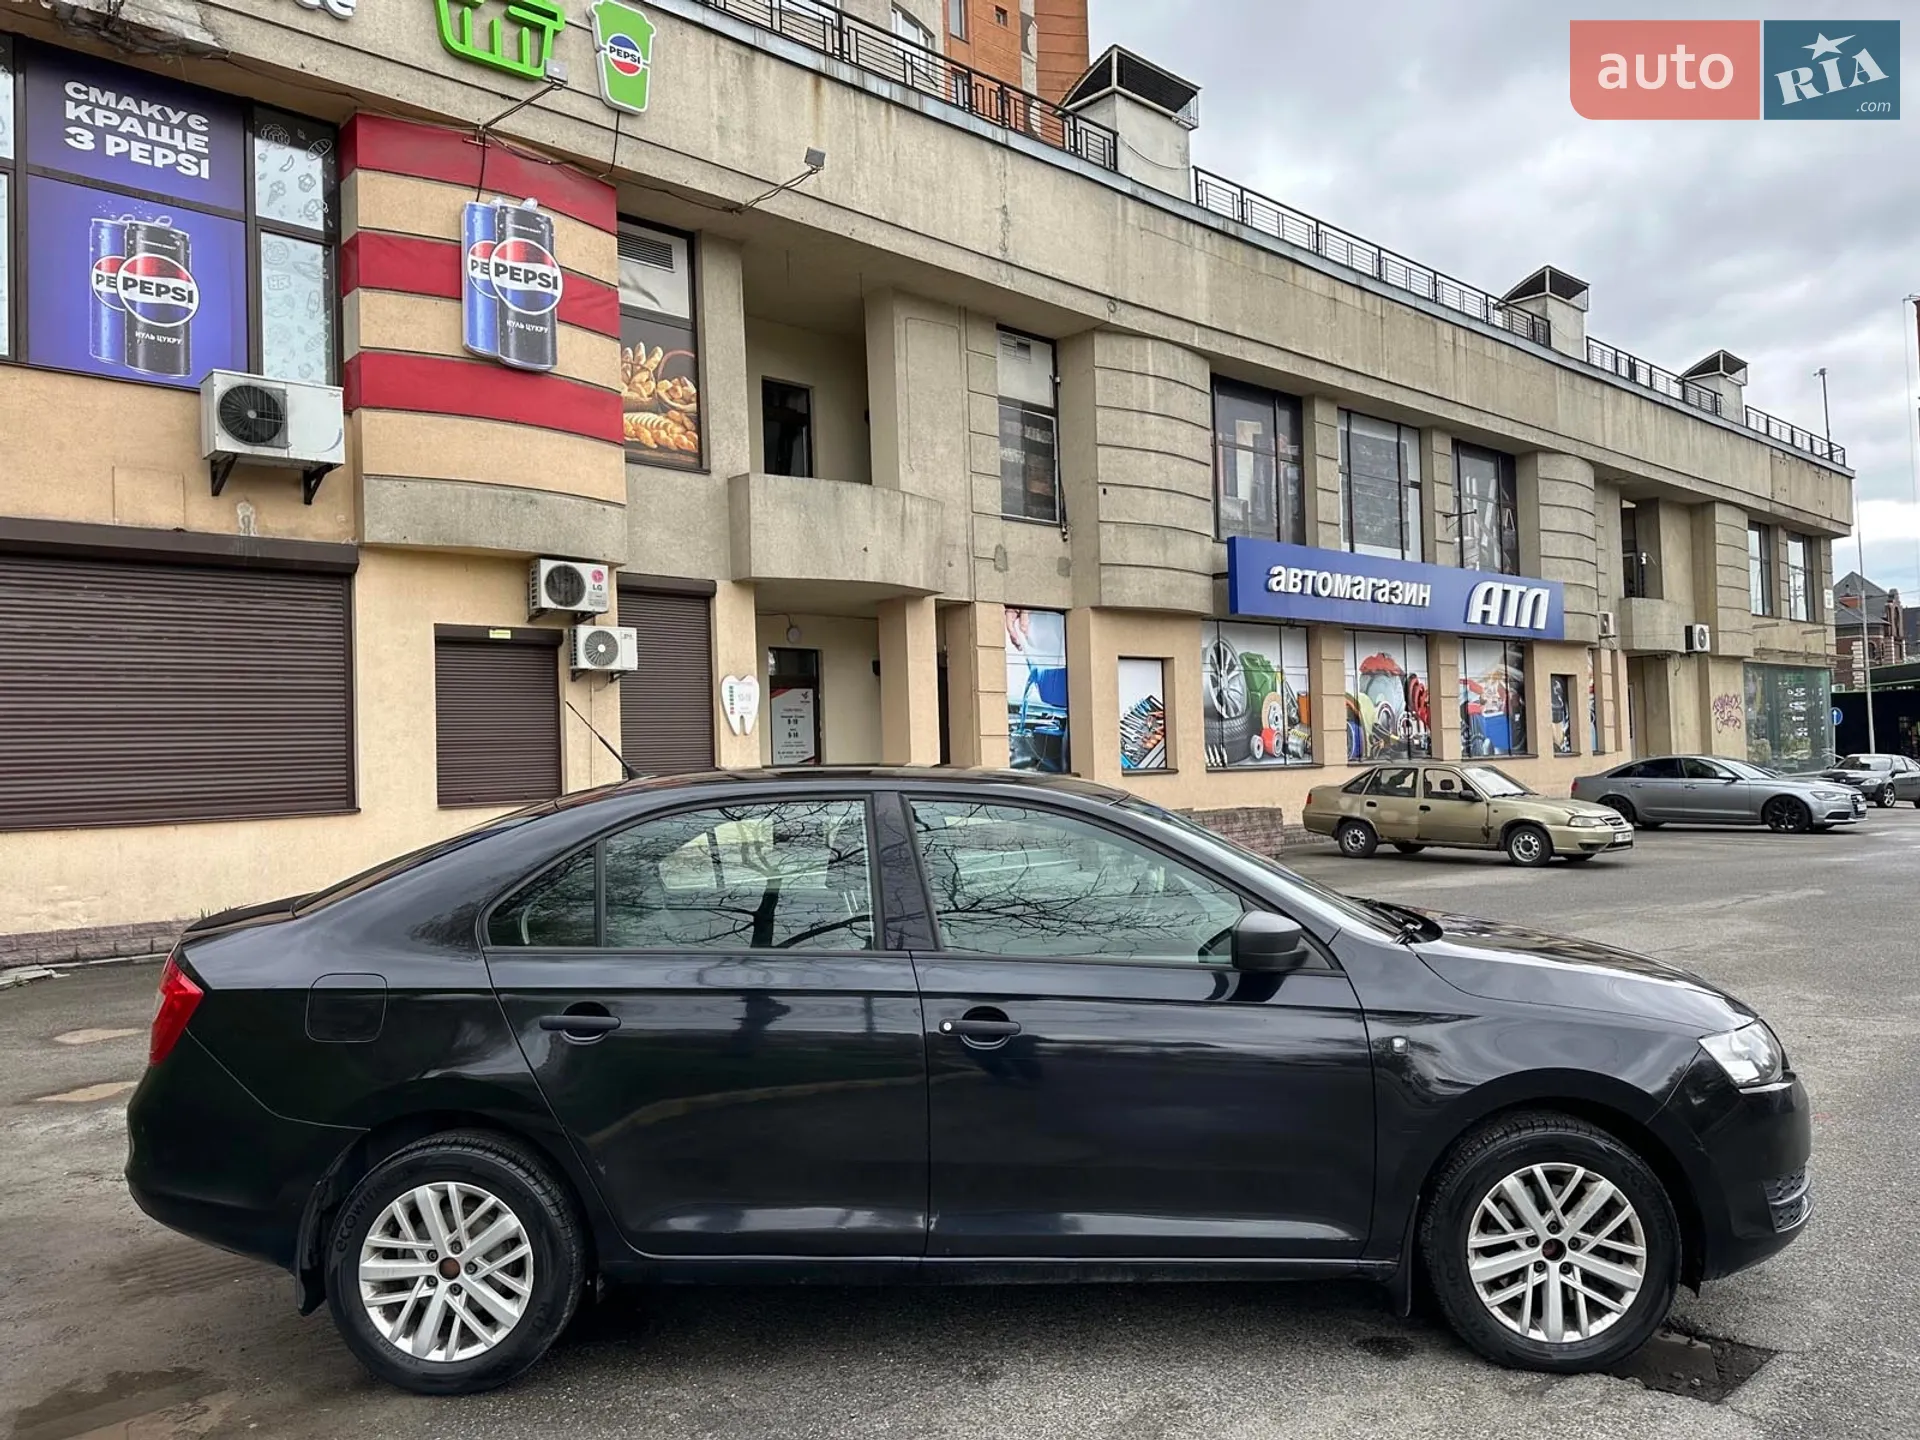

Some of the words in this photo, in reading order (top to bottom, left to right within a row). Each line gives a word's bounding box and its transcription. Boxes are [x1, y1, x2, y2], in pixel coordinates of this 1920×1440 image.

[609, 45, 641, 64] PEPSI
[64, 81, 210, 132] СМАКУЄ
[65, 100, 210, 154] КРАЩЕ
[105, 134, 211, 180] PEPSI
[122, 276, 195, 305] PEPSI
[494, 262, 559, 291] PEPSI
[592, 584, 603, 592] LG
[1268, 564, 1432, 608] автомагазин
